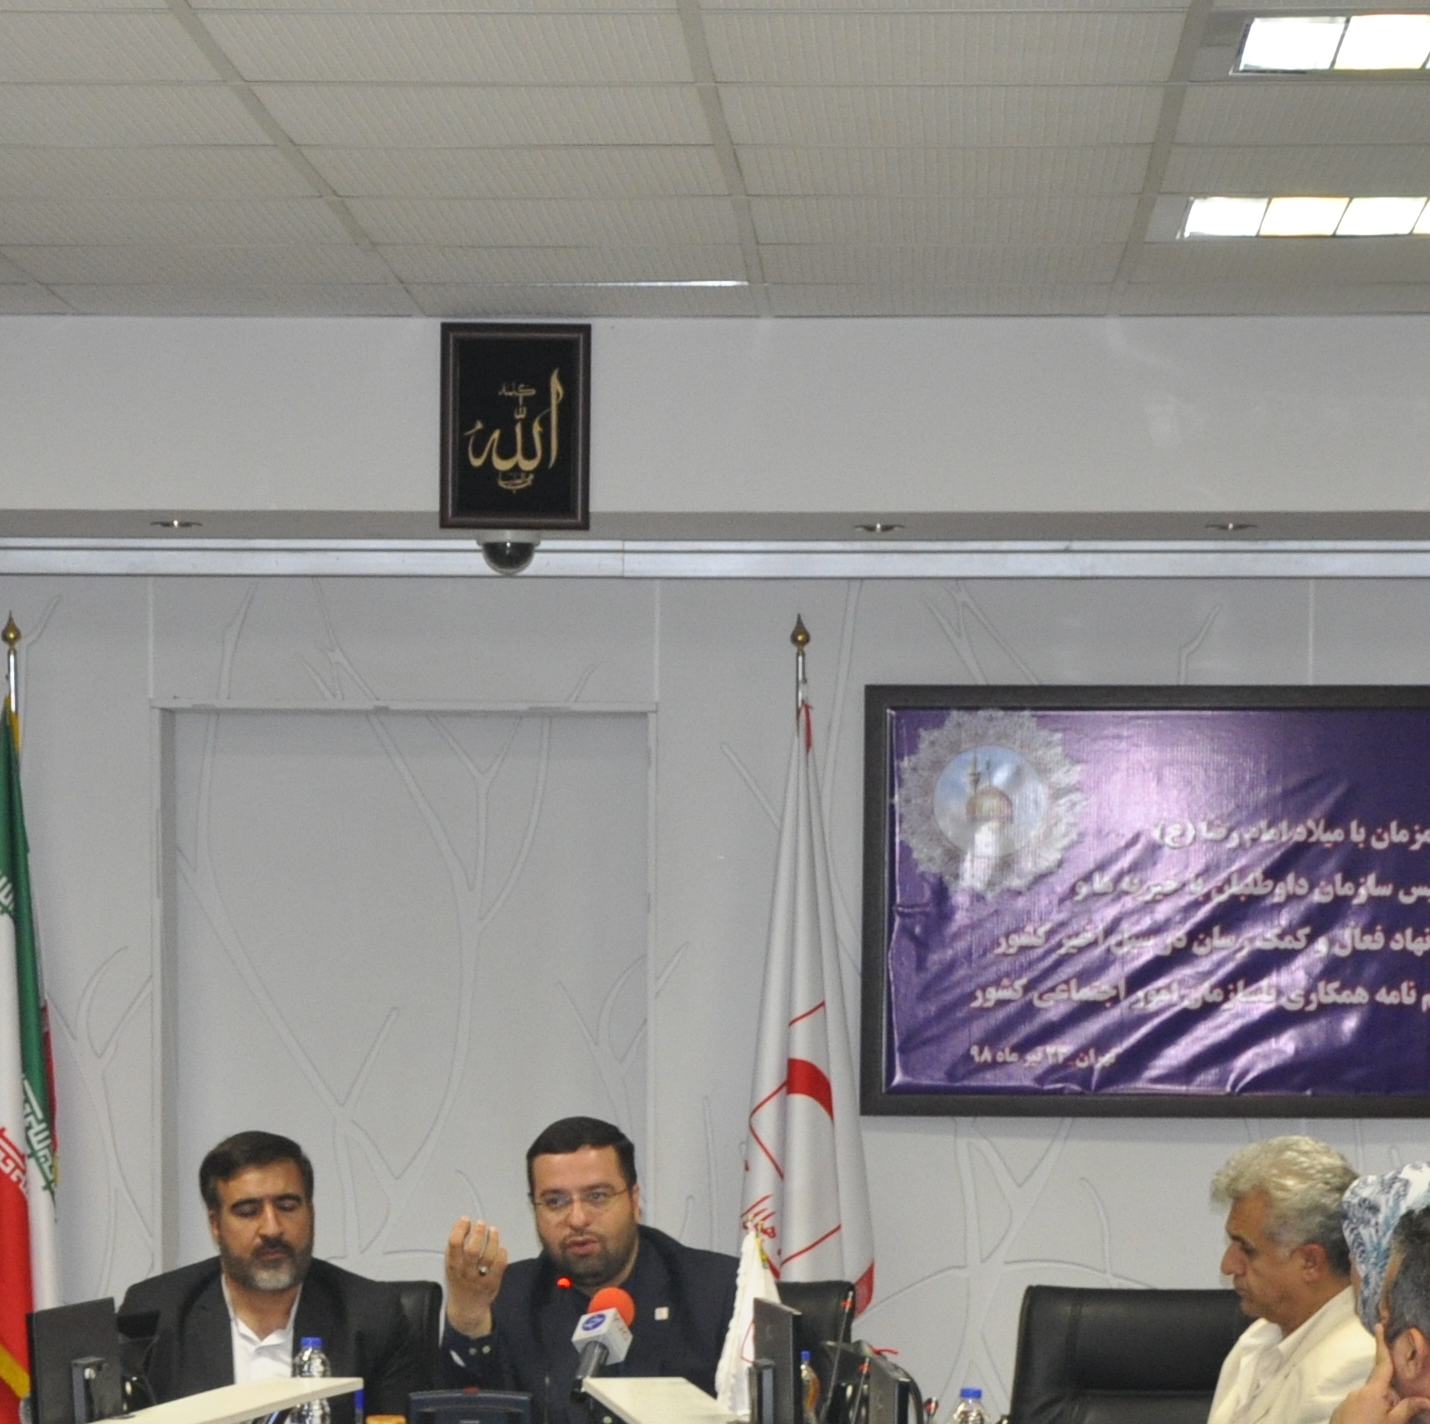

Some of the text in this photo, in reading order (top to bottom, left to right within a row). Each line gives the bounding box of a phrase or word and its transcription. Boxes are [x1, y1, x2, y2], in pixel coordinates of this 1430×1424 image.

[464, 367, 564, 471] الله
[1292, 818, 1345, 847] میلاد
[1349, 819, 1366, 848] با
[1313, 872, 1393, 905] سازمان
[993, 922, 1053, 955] کشور
[1333, 921, 1386, 957] فعال
[969, 976, 1029, 1009] کشور
[1032, 977, 1127, 1009] اجتماعی
[1281, 979, 1369, 1012] همکاری
[1374, 979, 1418, 1006] نامه
[969, 1044, 993, 1064] ۹۸
[995, 1046, 1019, 1063] ماه
